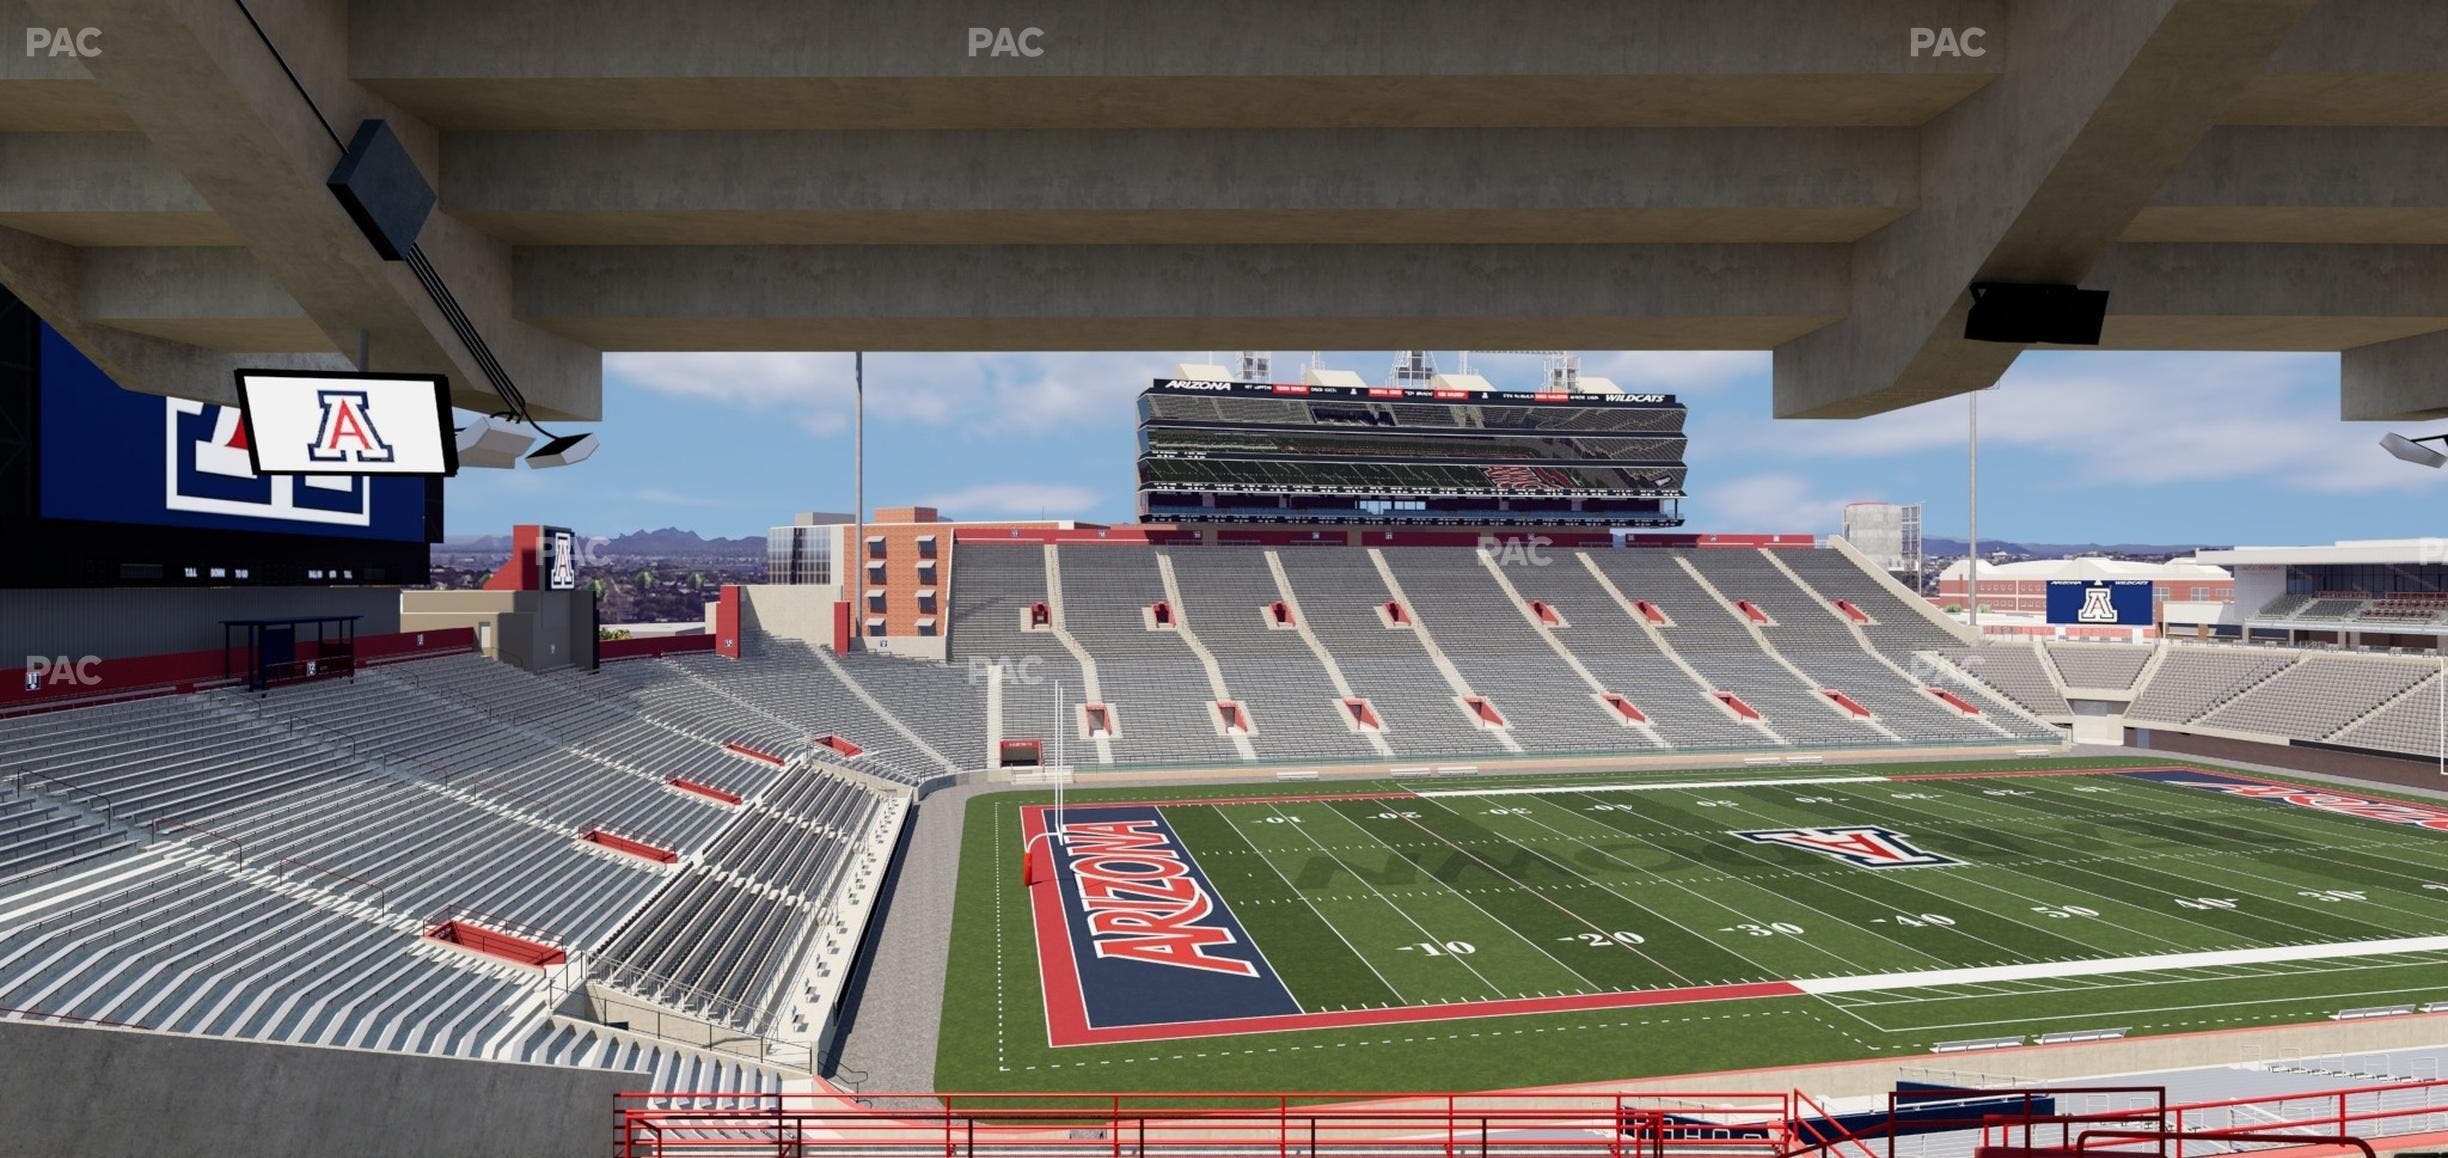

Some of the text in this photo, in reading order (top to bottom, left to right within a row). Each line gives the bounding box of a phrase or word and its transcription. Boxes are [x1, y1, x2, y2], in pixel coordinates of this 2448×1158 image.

[1165, 380, 1232, 392] ARIZONA
[1605, 392, 1665, 403] WILDCATS
[1266, 816, 1302, 824] 10
[1378, 811, 1422, 820] 20
[1061, 820, 1261, 978] ARIZONA
[2031, 904, 2100, 919] 50
[1895, 912, 1957, 928] 40
[1735, 921, 1805, 938] 30
[1577, 930, 1646, 948] 20
[1413, 940, 1476, 957] 10
